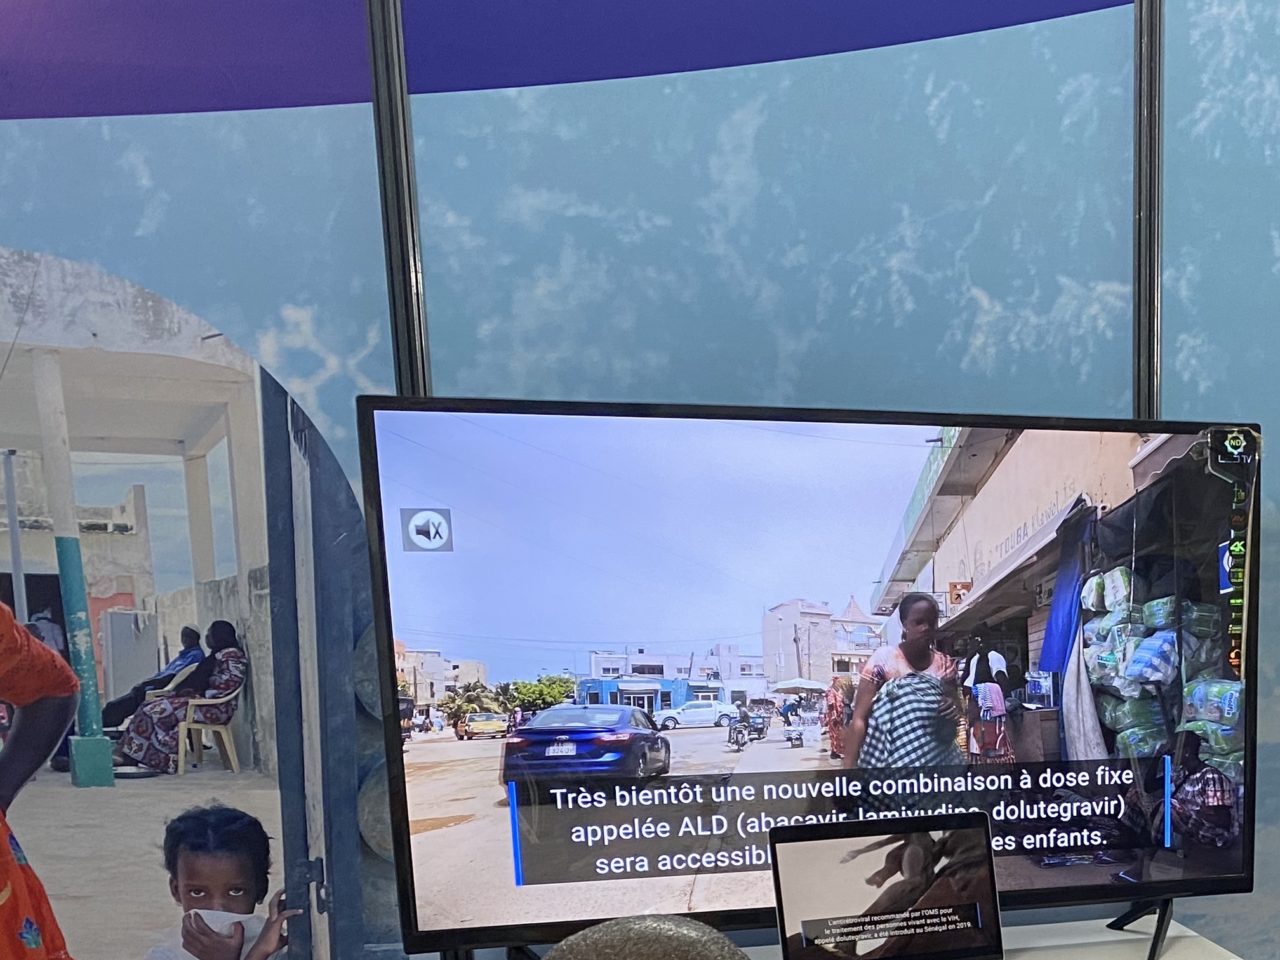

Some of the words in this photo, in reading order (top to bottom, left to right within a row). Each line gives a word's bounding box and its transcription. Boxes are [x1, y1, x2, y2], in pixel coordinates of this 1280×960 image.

[550, 787, 607, 809] Très
[615, 783, 704, 807] bientôt
[711, 784, 755, 801] une
[763, 776, 862, 800] nouvelle
[869, 771, 1012, 796] combinaison
[1019, 769, 1032, 789] à
[1039, 768, 1090, 788] dose
[1096, 765, 1134, 785] fixe
[571, 817, 671, 847] appelée
[678, 815, 728, 837] ALD
[992, 794, 1125, 822] dolutegravir)
[596, 855, 649, 875] sera
[657, 843, 772, 871] accessibl
[1022, 828, 1108, 849] enfants.
[831, 924, 863, 934] traitement
[863, 923, 875, 931] des
[876, 919, 907, 930] personnes
[908, 918, 926, 926] vivant
[871, 911, 910, 921] recommandé
[921, 908, 939, 916] l'OMS
[940, 907, 954, 915] pour
[890, 928, 915, 937] introduit
[924, 924, 947, 933] Sénégal
